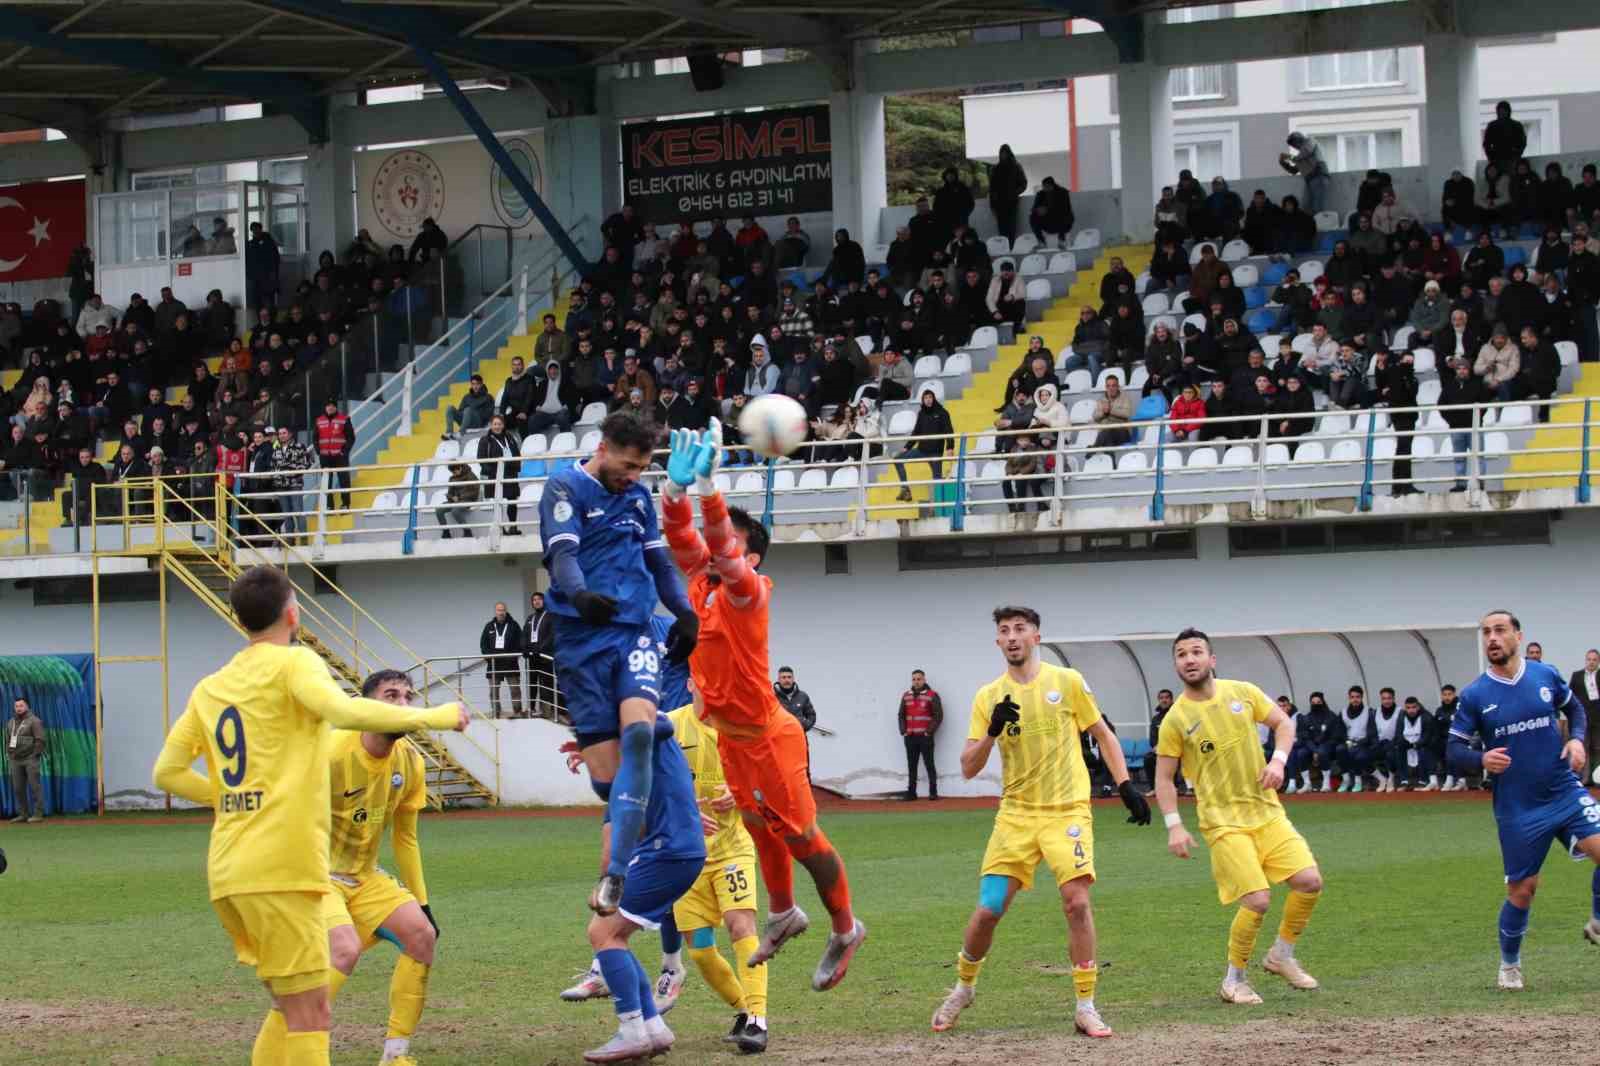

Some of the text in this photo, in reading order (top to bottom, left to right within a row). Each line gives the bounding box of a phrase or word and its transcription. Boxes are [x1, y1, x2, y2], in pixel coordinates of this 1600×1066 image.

[632, 115, 831, 169] KESİMAL
[629, 170, 711, 196] ELEKTRİK
[679, 188, 794, 213] 0464 612 31 41
[628, 649, 659, 673] 99
[215, 704, 247, 788] 9
[1074, 840, 1085, 859] 4
[725, 869, 748, 893] 35
